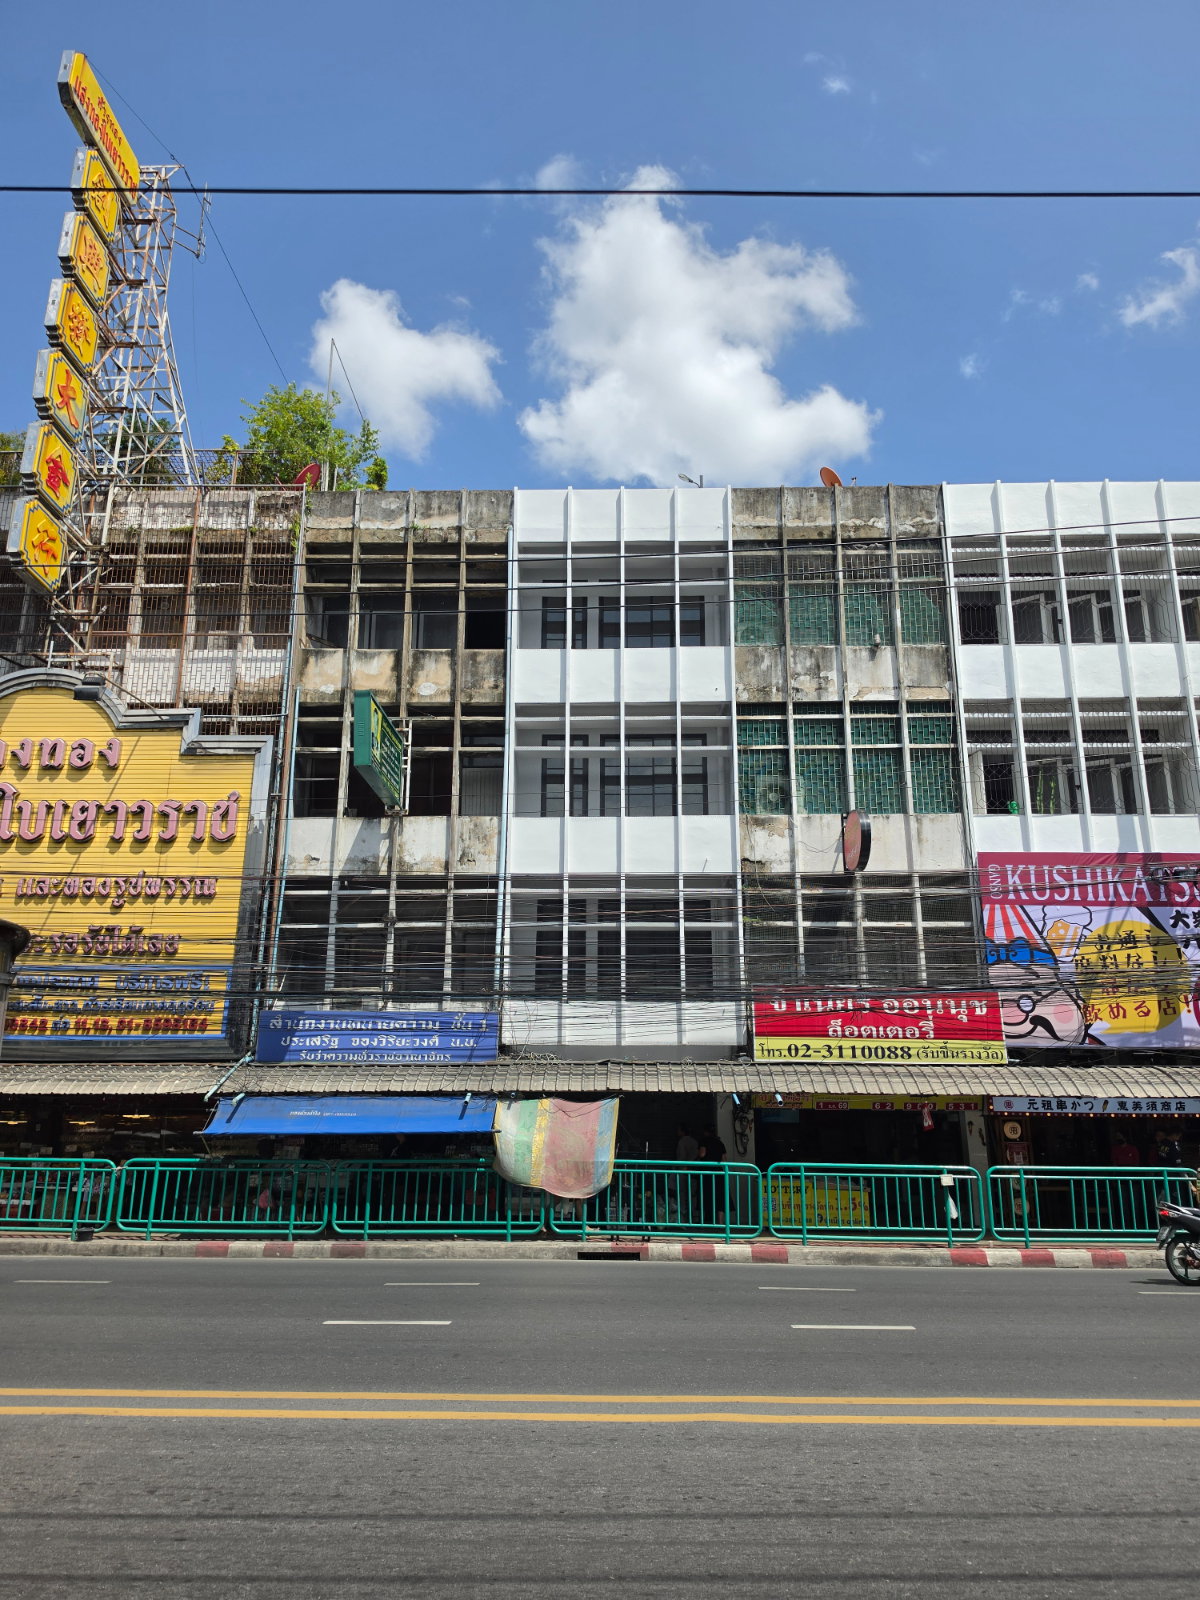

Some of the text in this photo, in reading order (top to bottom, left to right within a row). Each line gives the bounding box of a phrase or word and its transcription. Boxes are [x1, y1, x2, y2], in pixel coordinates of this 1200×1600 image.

[0, 737, 122, 770] งทอง
[24, 924, 182, 957] ะรอรับได้เลย
[882, 998, 988, 1022] ออนนุช
[827, 1014, 935, 1039] ล็อตเตอรี่
[280, 1034, 340, 1049] ประเสริฐ
[1027, 1098, 1094, 1112] 元祖串かつ
